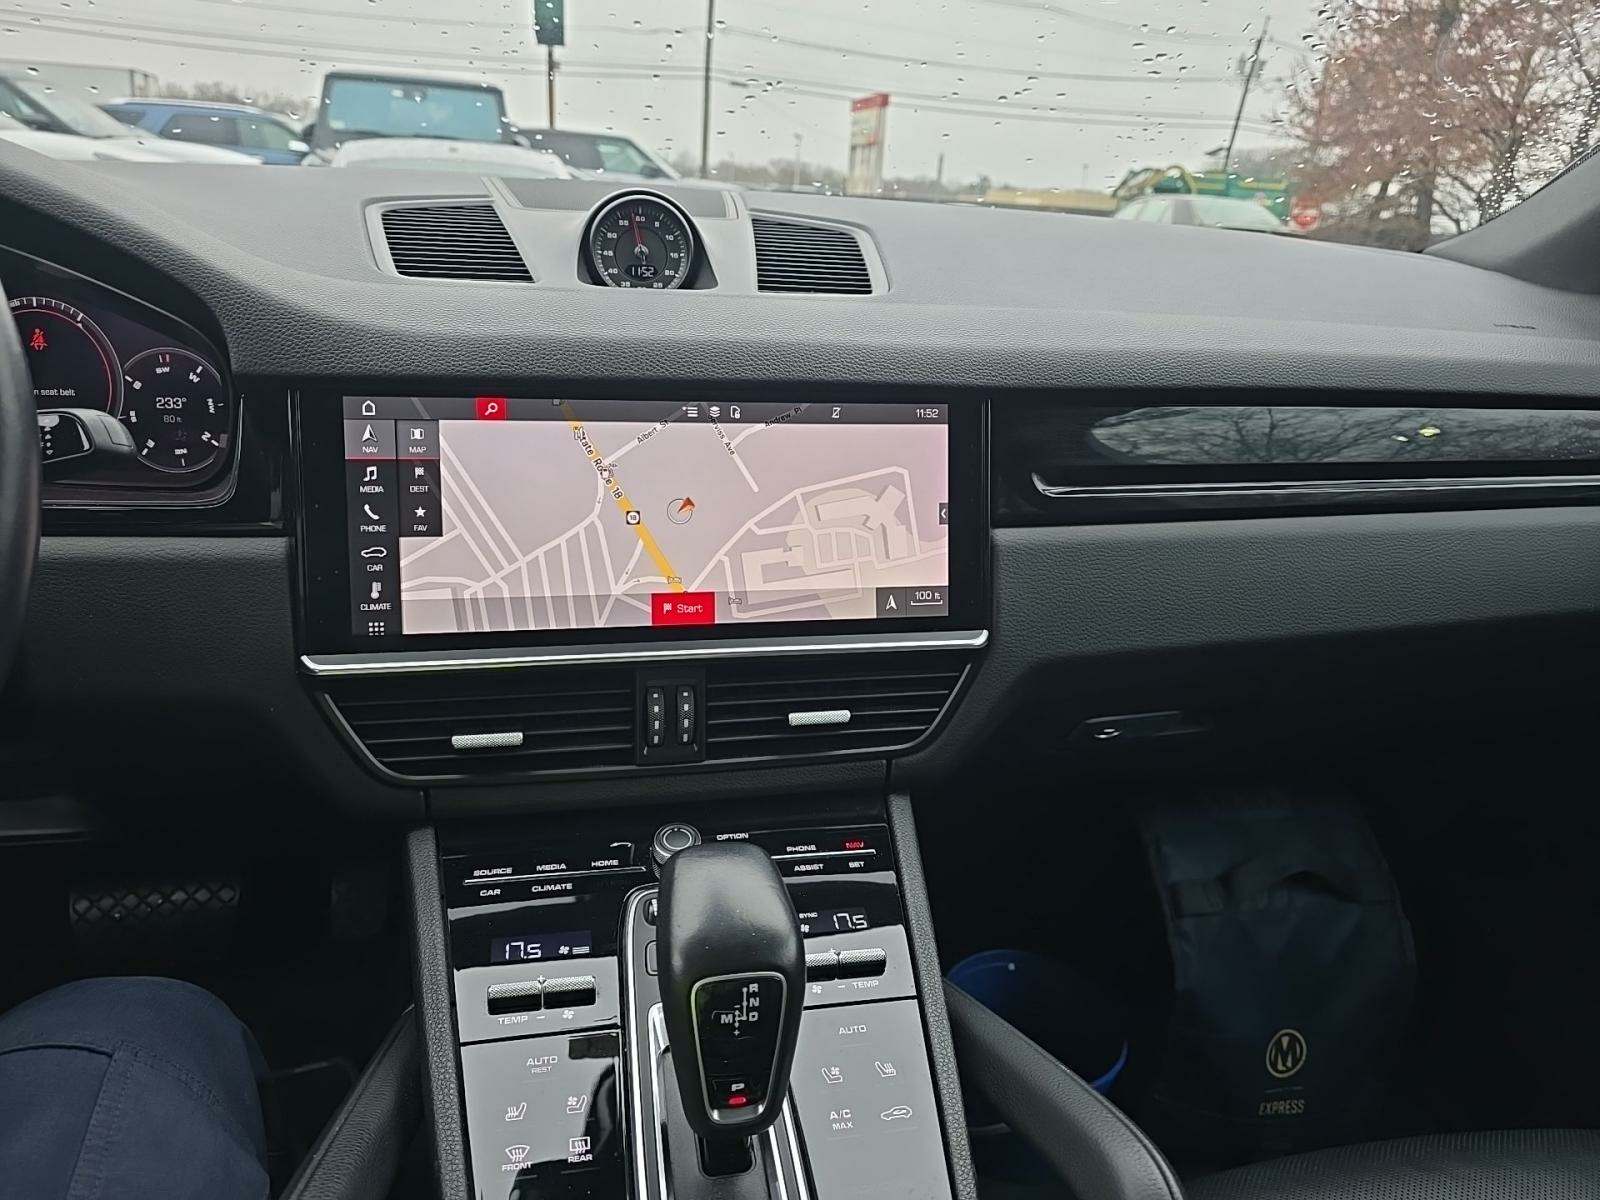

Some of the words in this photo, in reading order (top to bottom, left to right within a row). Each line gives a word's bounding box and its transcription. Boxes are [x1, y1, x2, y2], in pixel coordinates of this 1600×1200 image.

[155, 366, 170, 374] SW
[188, 372, 201, 383] W
[915, 408, 939, 419] 11:52
[764, 412, 791, 427] Andrew
[636, 427, 659, 444] Albert
[724, 441, 736, 456] Ave
[359, 485, 384, 493] MEDIA
[409, 485, 429, 493] DEST
[612, 486, 624, 500] 18
[360, 524, 387, 533] PHONE
[413, 524, 428, 532] FAV
[366, 563, 383, 572] CAR
[914, 590, 932, 601] 100
[360, 602, 392, 611] CLIMATE
[676, 602, 704, 615] Start
[716, 832, 749, 841] OPTION
[786, 844, 817, 853] PHONE
[536, 862, 567, 872] MEDIA
[591, 859, 619, 868] HOME
[793, 863, 824, 872] ASSIST
[473, 866, 513, 877] SOURCE
[479, 888, 501, 897] CAR
[531, 882, 573, 893] CLIMATE
[749, 983, 758, 992] R
[852, 979, 879, 989] TEMP
[749, 997, 759, 1007] N
[498, 1015, 528, 1025] TEMP
[720, 1013, 733, 1024] M
[748, 1012, 758, 1022] D
[838, 1024, 867, 1035] AUTO
[526, 1055, 558, 1067] AUTO
[531, 1066, 552, 1074] REST
[731, 1083, 745, 1092] P
[1259, 1099, 1305, 1115] EXPRESS
[829, 1109, 852, 1121] A/C
[832, 1121, 853, 1131] MAX
[567, 1154, 593, 1164] REAR
[501, 1162, 533, 1172] FRONT
